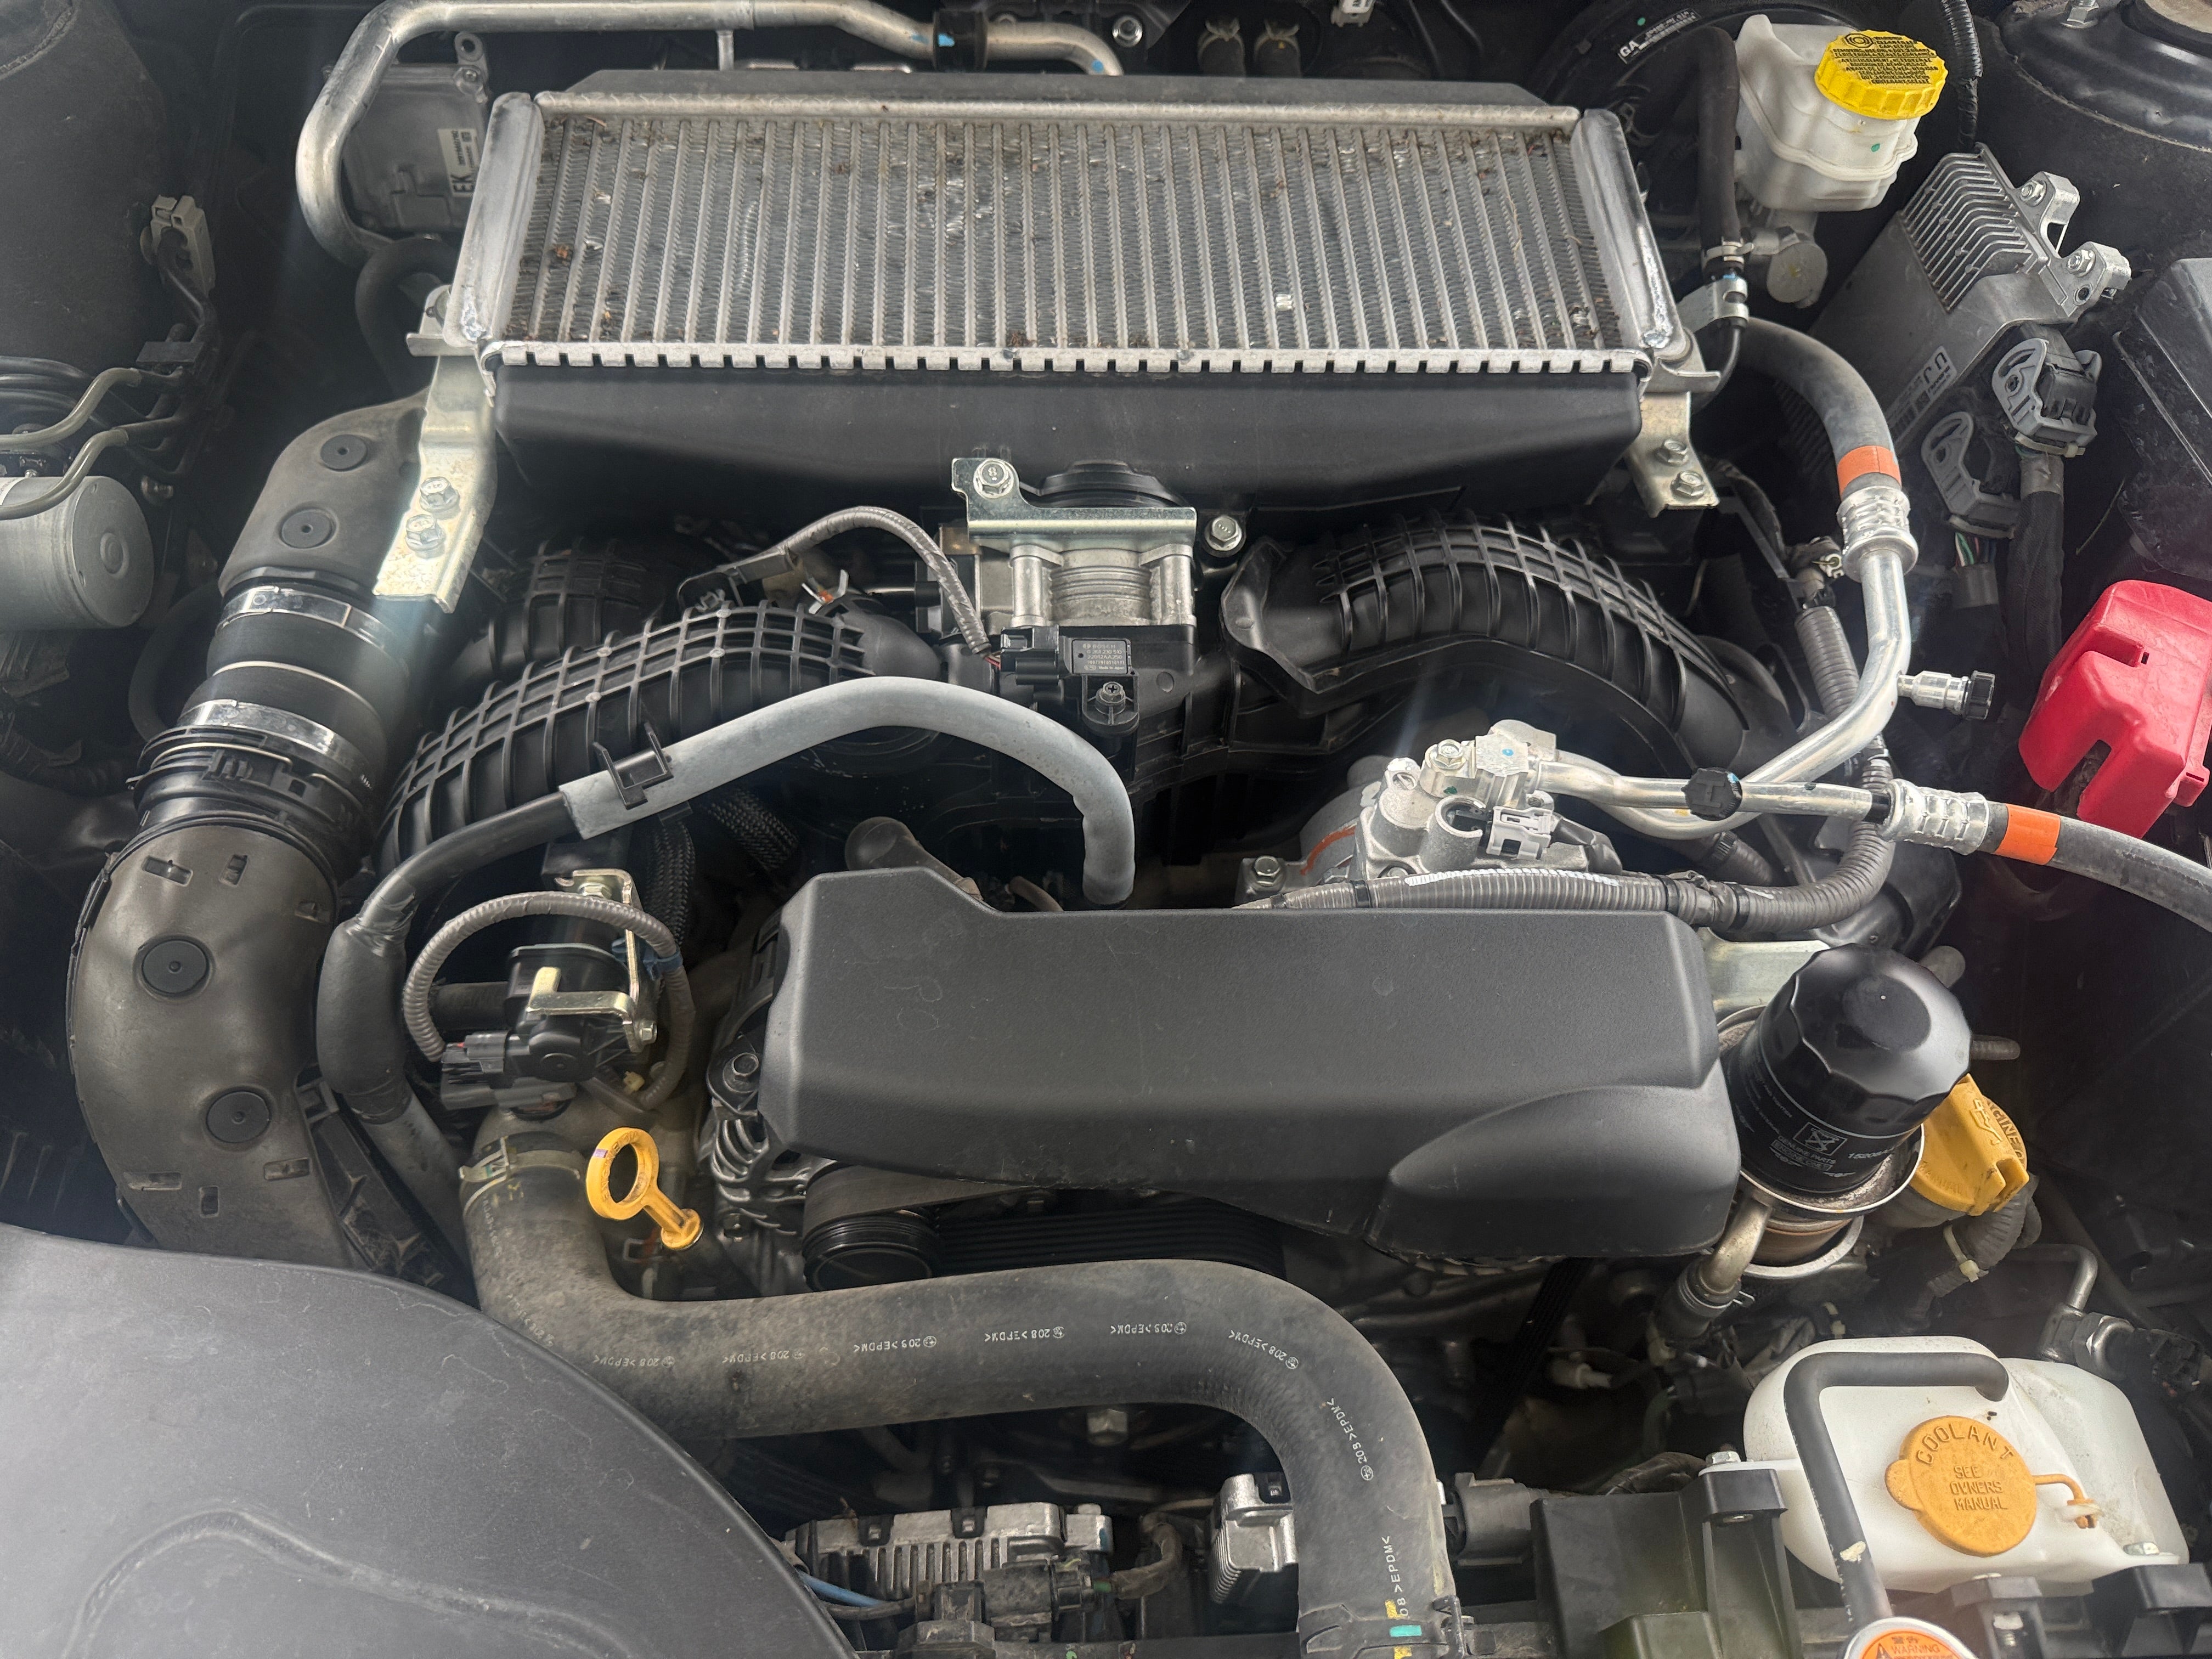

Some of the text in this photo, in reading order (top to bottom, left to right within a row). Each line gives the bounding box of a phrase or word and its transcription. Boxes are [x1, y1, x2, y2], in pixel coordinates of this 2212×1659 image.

[1620, 40, 1640, 57] GA
[1915, 1423, 2014, 1465] COOLANT
[1953, 1465, 1982, 1480] SEE
[1950, 1481, 2003, 1496] OWNERS
[1954, 1496, 2008, 1511] MANUAL
[1397, 1598, 1409, 1617] 08
[1892, 1644, 1940, 1654] WARNING
